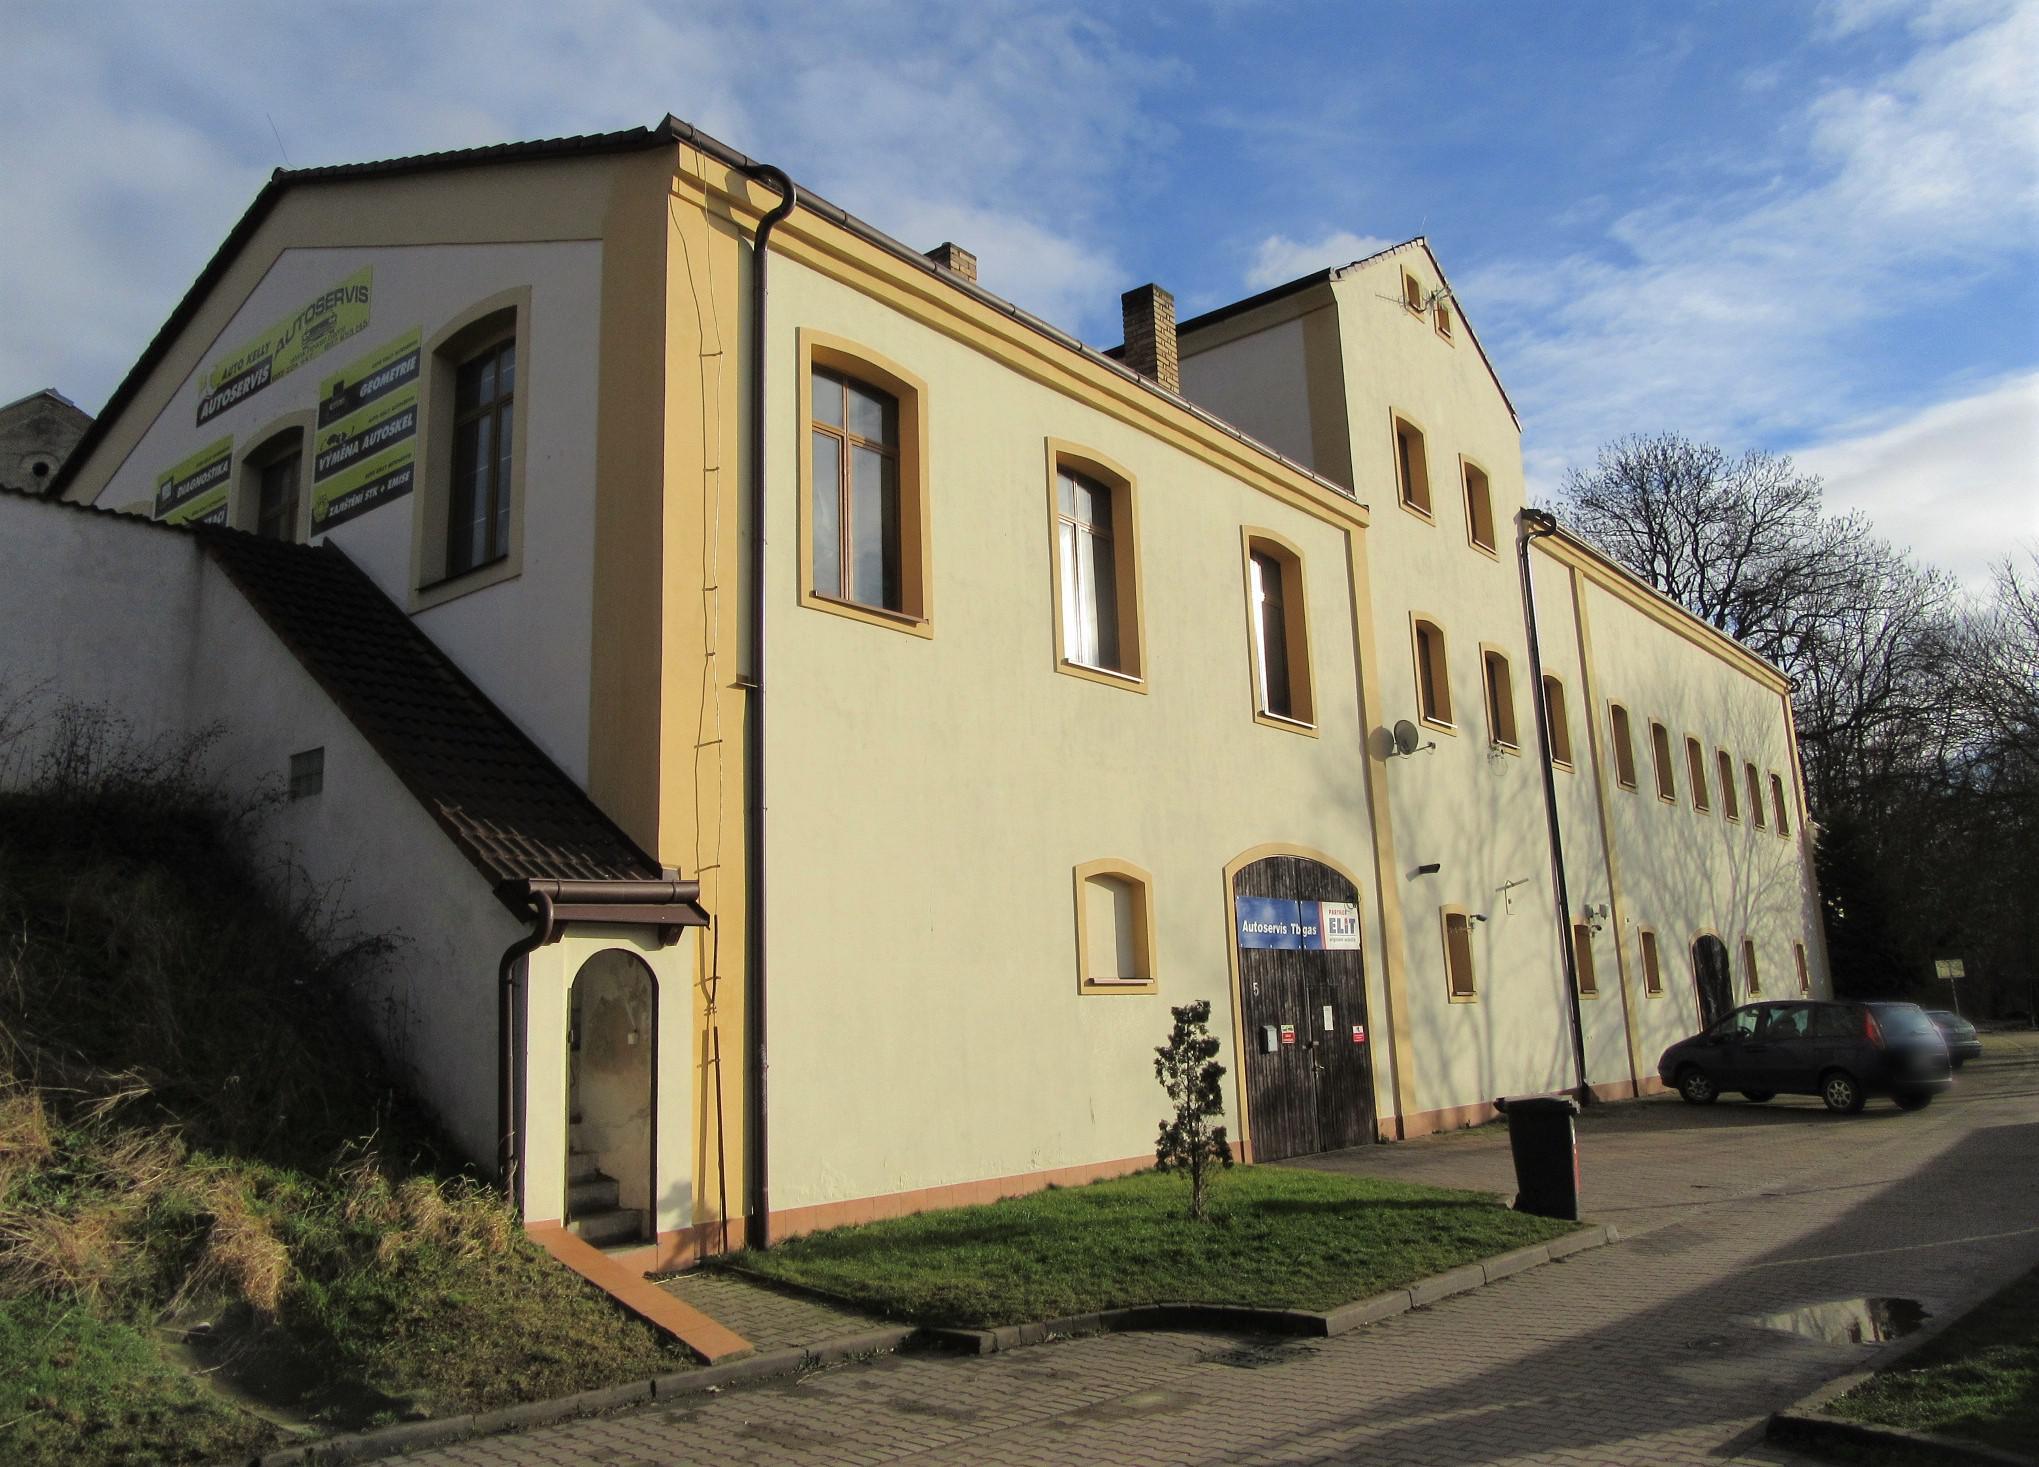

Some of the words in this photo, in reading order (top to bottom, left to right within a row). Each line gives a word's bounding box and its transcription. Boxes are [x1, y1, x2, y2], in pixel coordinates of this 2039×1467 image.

[274, 285, 369, 359] AUTOSERVIS
[222, 357, 244, 379] AUTO
[360, 356, 417, 398] GEOMETRIE
[200, 364, 270, 420] AUTOSERVIS
[361, 413, 413, 450] AUTOSKEL
[177, 460, 228, 498] DIAGNOSTIKA
[364, 486, 378, 501] STK
[388, 471, 410, 490] EMISE
[1242, 920, 1288, 935] Autoservis
[1252, 982, 1259, 997] 5
